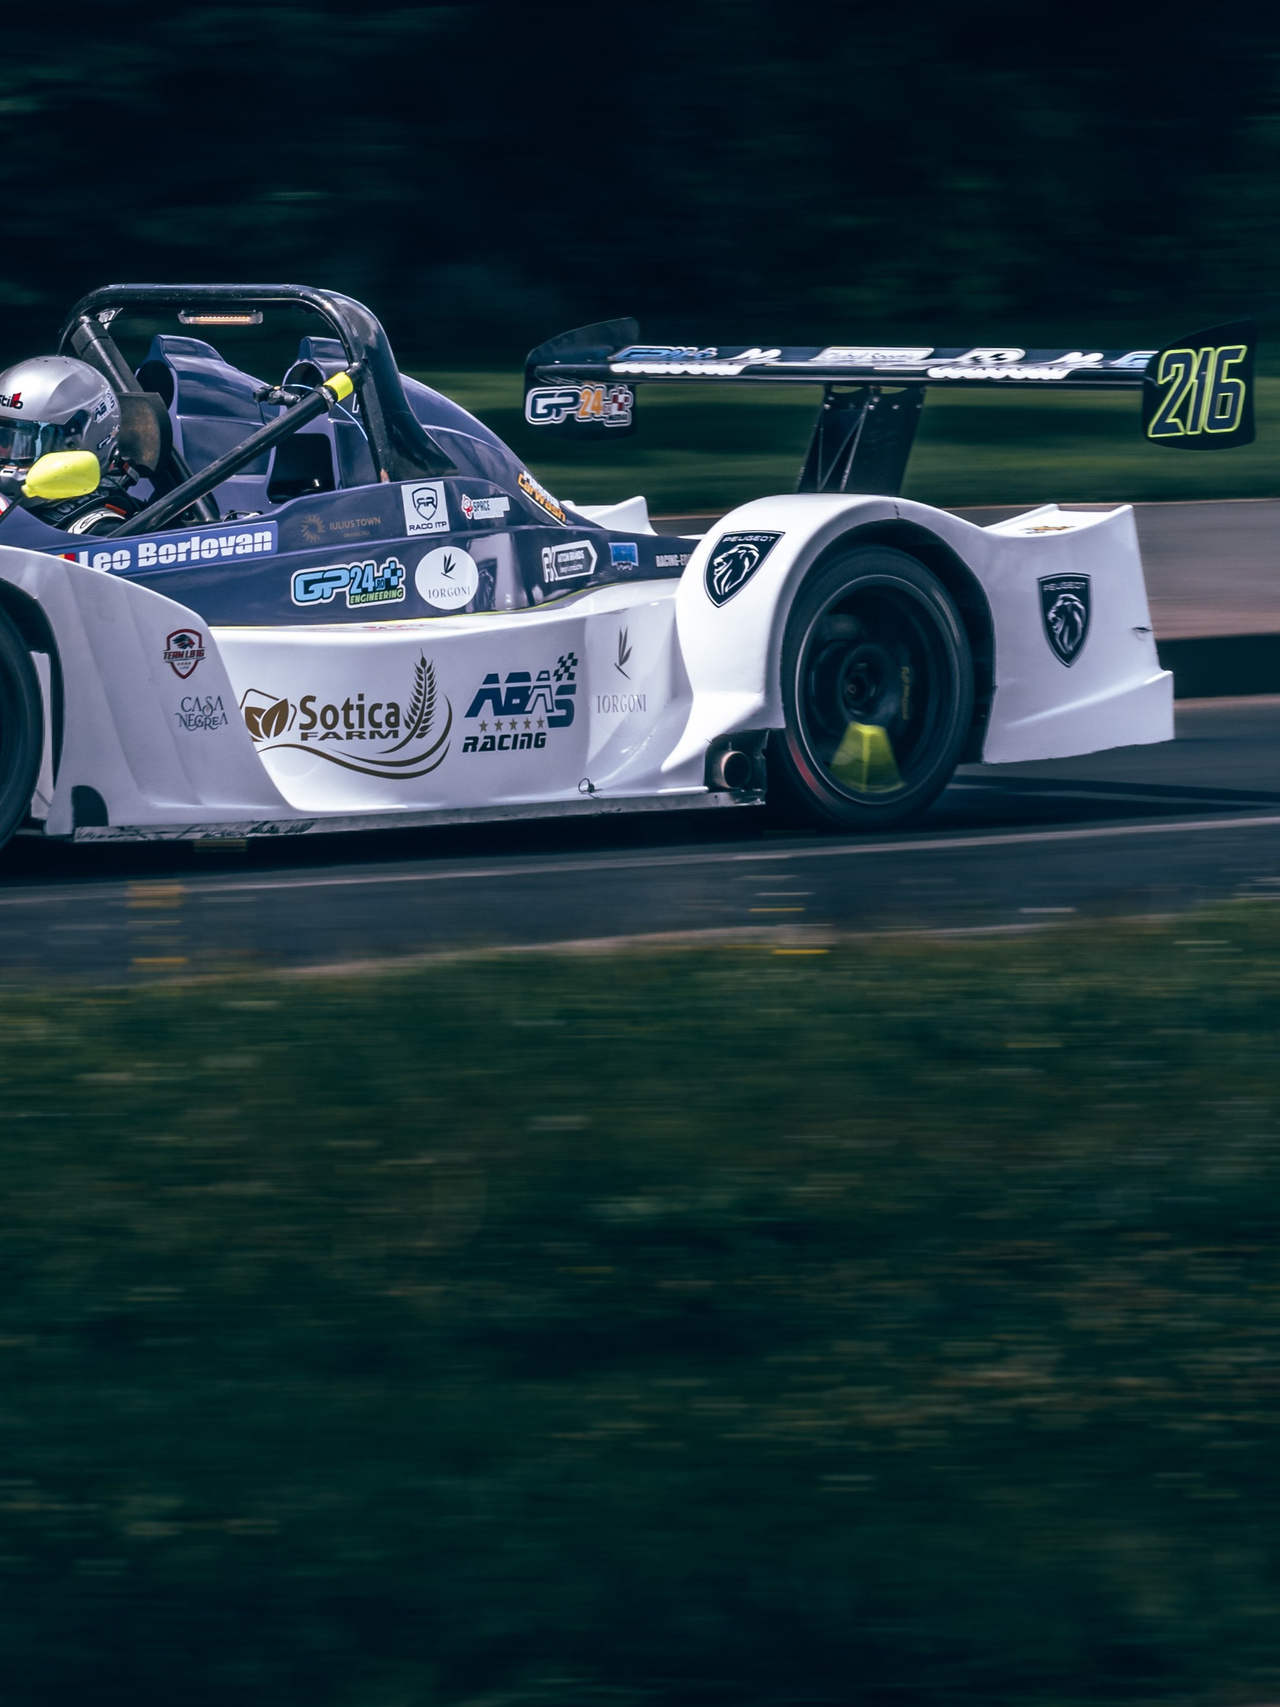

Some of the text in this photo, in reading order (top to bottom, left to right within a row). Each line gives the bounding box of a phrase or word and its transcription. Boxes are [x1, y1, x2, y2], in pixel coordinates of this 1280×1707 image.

[1147, 345, 1248, 438] 216
[355, 516, 382, 528] TOWN
[409, 520, 448, 531] RACO ITP
[722, 535, 777, 543] PEUGEOT
[138, 530, 273, 568] Borlovan
[350, 589, 403, 605] ENGINEERING
[428, 586, 470, 599] IORGONI
[163, 651, 185, 660] TEAM
[181, 694, 224, 717] CASA
[299, 693, 401, 730] Sotica
[596, 693, 647, 714] IORGONI
[300, 729, 399, 741] FARM
[462, 731, 547, 753] RACING
